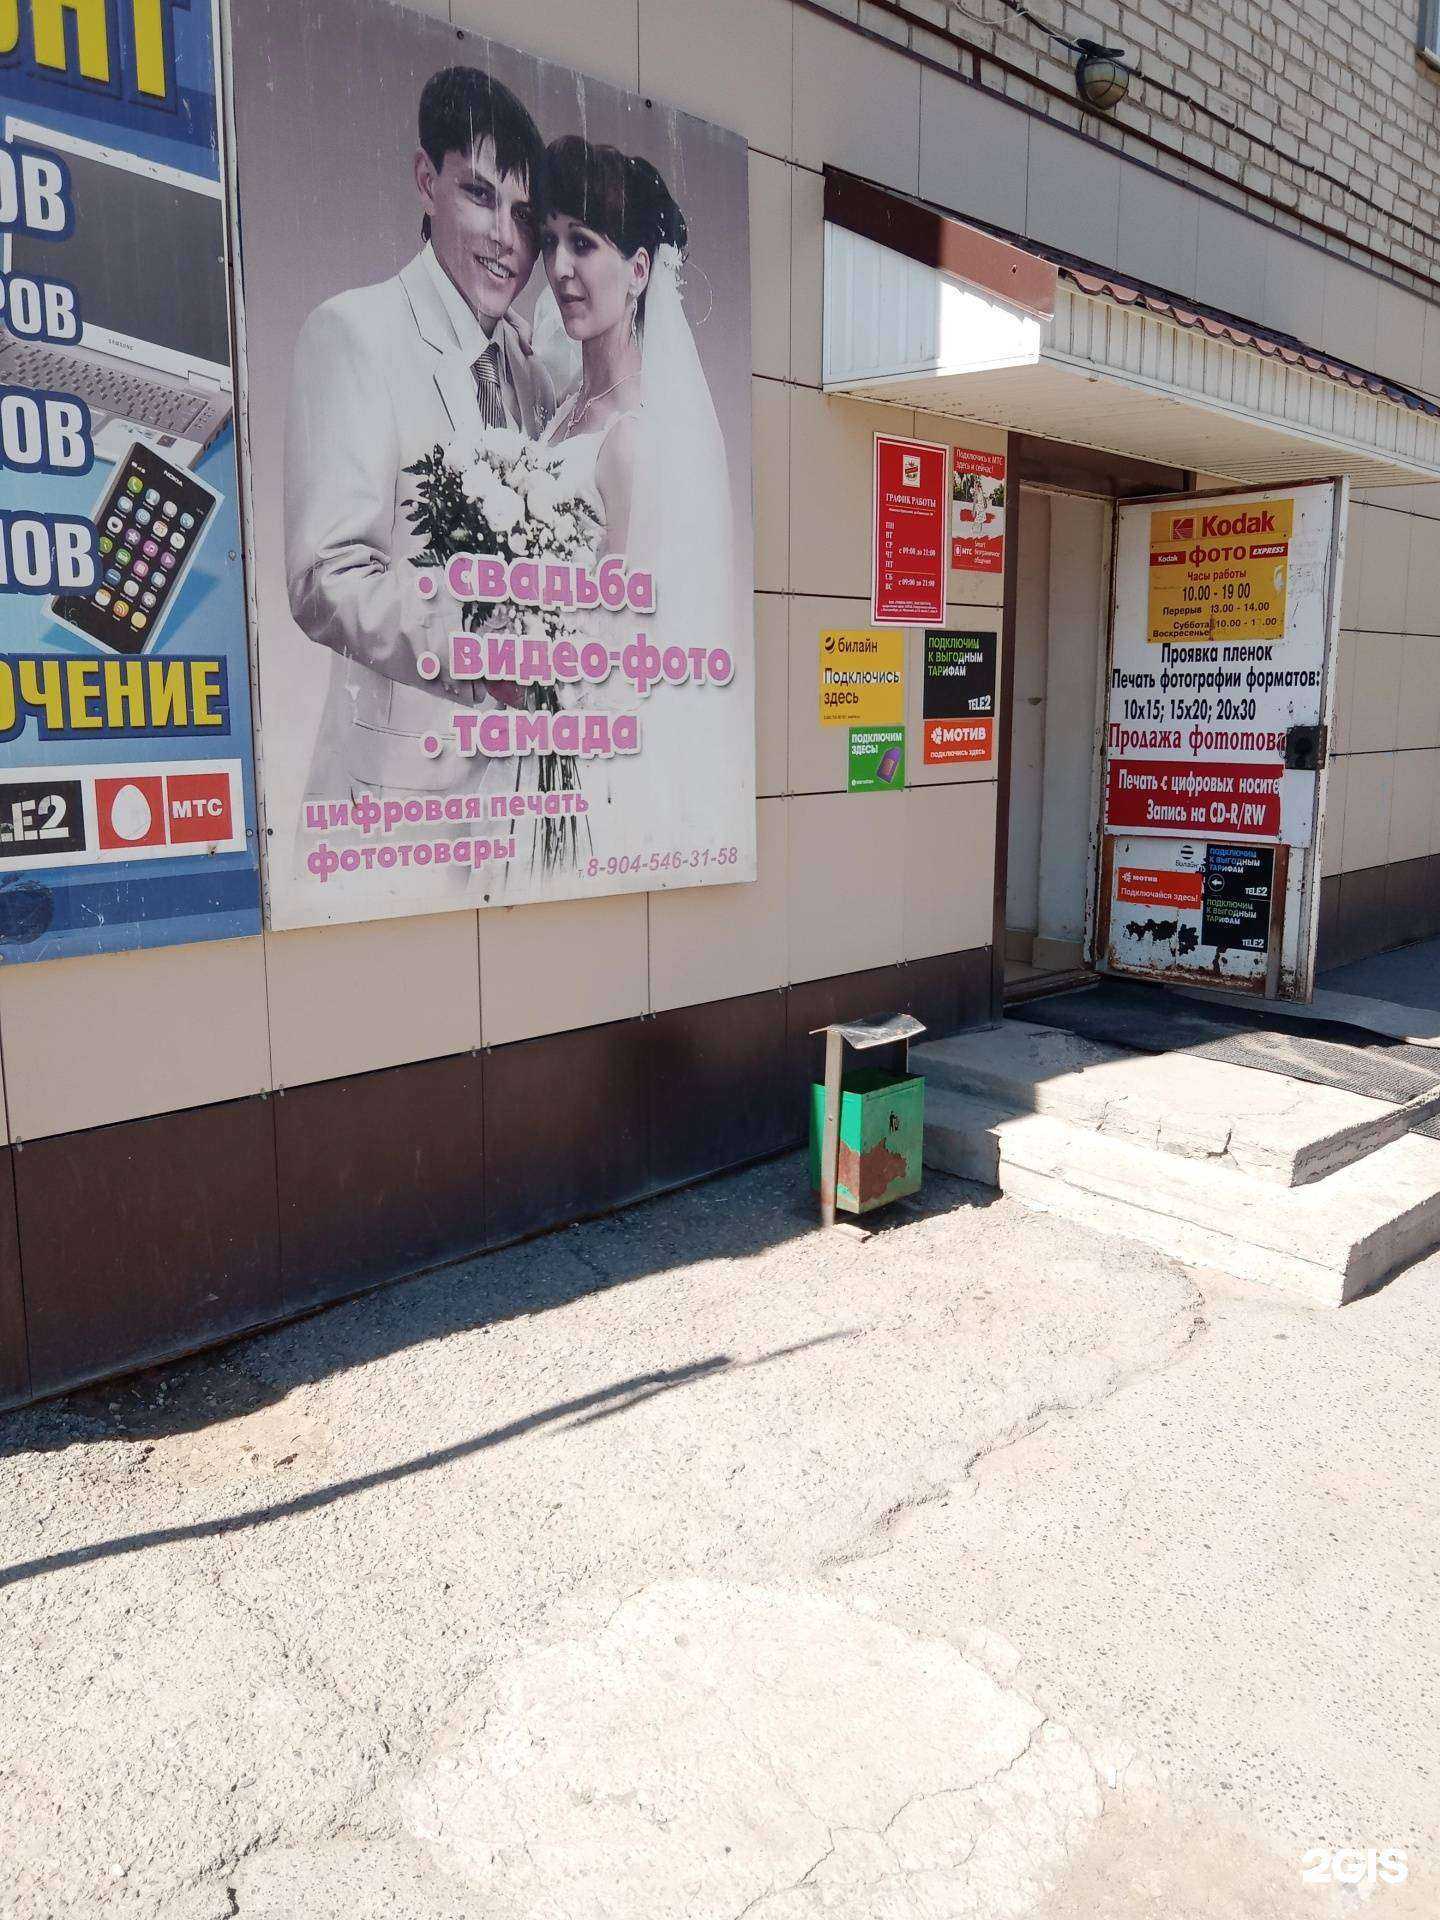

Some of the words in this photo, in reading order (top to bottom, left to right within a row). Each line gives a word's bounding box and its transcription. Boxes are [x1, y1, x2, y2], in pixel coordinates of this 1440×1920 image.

[163, 469, 185, 488] NOKIA
[886, 493, 911, 504] ГРАФИК
[912, 496, 936, 508] РАБОТЫ
[1201, 511, 1275, 537] Kodak
[0, 519, 94, 588] ОВ
[1158, 554, 1178, 562] Kodak
[1252, 545, 1285, 556] EXPRESS
[1187, 570, 1211, 581] Часы
[1213, 568, 1247, 582] работы
[449, 558, 653, 609] свадьба
[1183, 585, 1210, 602] 10.00
[1163, 606, 1202, 617] Перерыв
[1210, 604, 1234, 614] 13.00
[1244, 602, 1270, 612] 14.00
[1173, 621, 1209, 631] Суббота
[1216, 620, 1241, 628] 10.00
[838, 637, 878, 653] билайн
[928, 637, 979, 650] ПОДКЛЮЧИМ
[452, 633, 732, 693] видео-фото
[936, 652, 983, 665] ВЫГОДНЫМ
[1161, 643, 1218, 667] Проявка
[1223, 645, 1273, 662] пленок
[825, 668, 900, 686] Подключись
[928, 666, 967, 677] ТАРИФАМ
[1112, 669, 1156, 689] Печать
[1160, 666, 1241, 693] фотографии
[1246, 665, 1321, 692] форматов:
[824, 691, 859, 706] здесь
[968, 695, 991, 711] TELE2
[453, 714, 638, 755] тамада
[852, 733, 902, 744] ПОДКЛЮЧИМ
[943, 726, 986, 742] МОТИВ
[1108, 723, 1181, 755] Продажа
[1119, 769, 1158, 790] Печать
[1160, 775, 1168, 790] с
[1171, 771, 1234, 797] цифровых
[172, 799, 223, 819] МТС
[306, 794, 481, 833] цифровая
[491, 792, 590, 818] печать
[1146, 799, 1187, 822] Запись
[1191, 806, 1206, 822] на
[1210, 802, 1266, 831] CD-R/RW
[1, 795, 69, 842] E2
[307, 838, 516, 883] фототовары
[587, 847, 738, 877] 8-904-546-31-58
[1216, 857, 1260, 867] ВЫГОДНЫМ
[1210, 864, 1244, 874] ТАРИФАМ
[1121, 887, 1172, 899] Подключайся
[1173, 893, 1199, 903] здесь!
[1245, 887, 1268, 896] TELE2
[1207, 915, 1240, 925] ТАРИФАМ
[1213, 908, 1257, 919] ВЫГОДНЫМ
[1242, 939, 1264, 948] TELE2
